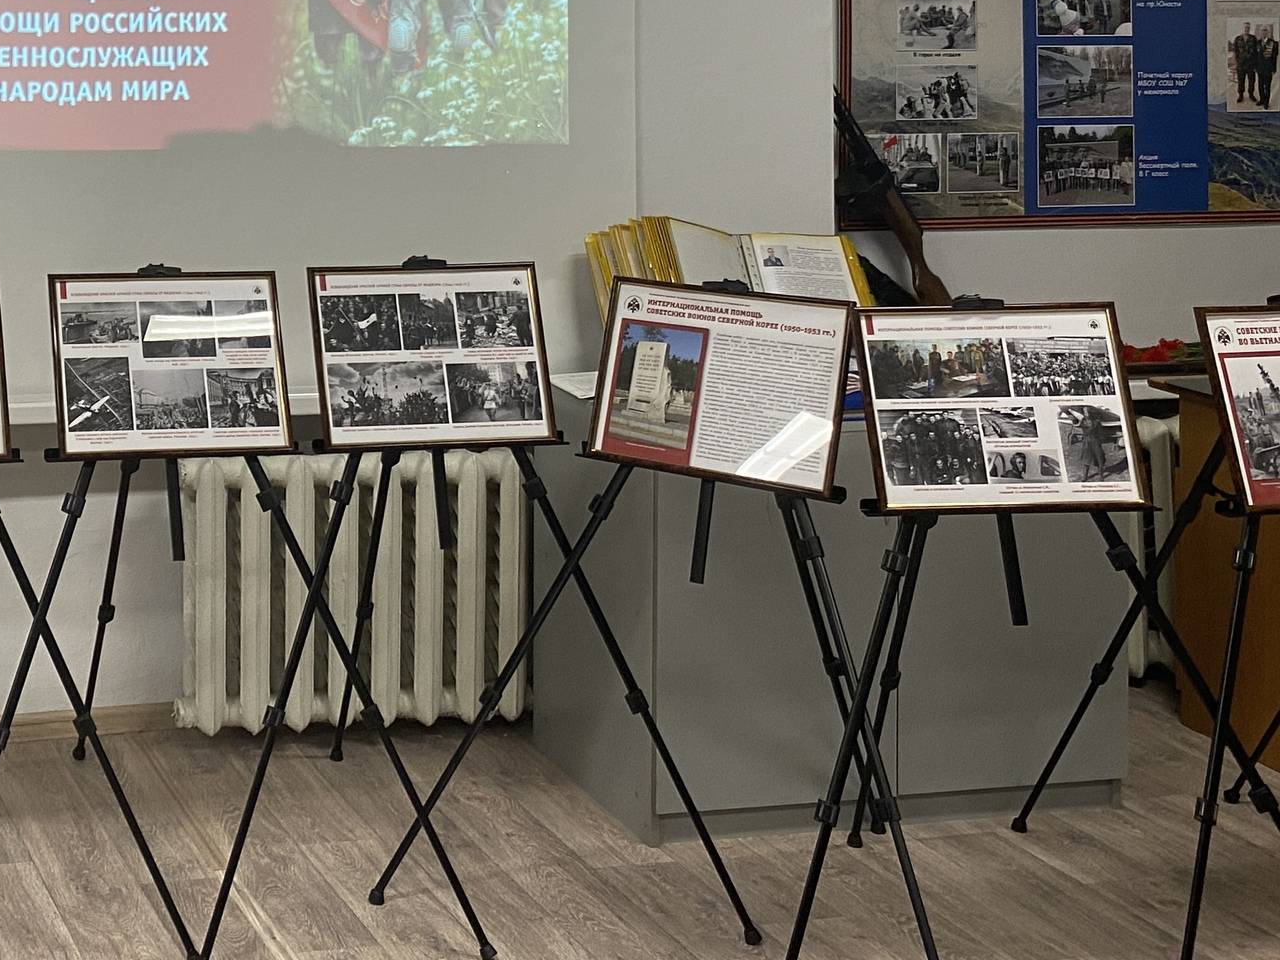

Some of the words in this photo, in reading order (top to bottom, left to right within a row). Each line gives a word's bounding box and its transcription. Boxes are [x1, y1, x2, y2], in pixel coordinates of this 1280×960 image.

[70, 6, 228, 34] РОССИЙСКИХ
[121, 80, 190, 102] МИРА
[646, 306, 686, 318] СОВЕТСКИХ
[687, 312, 716, 322] ВОИНОВ
[717, 314, 754, 327] СЕВЕРНОЙ
[755, 320, 779, 330] КОРЕЕ
[647, 298, 730, 315] ИНТЕРНАЦИОНАЛЬНАЯ
[730, 308, 763, 319] ПОМОЩЬ
[1236, 326, 1278, 335] СОВЕТСКИЕ
[1238, 338, 1249, 346] ВО
